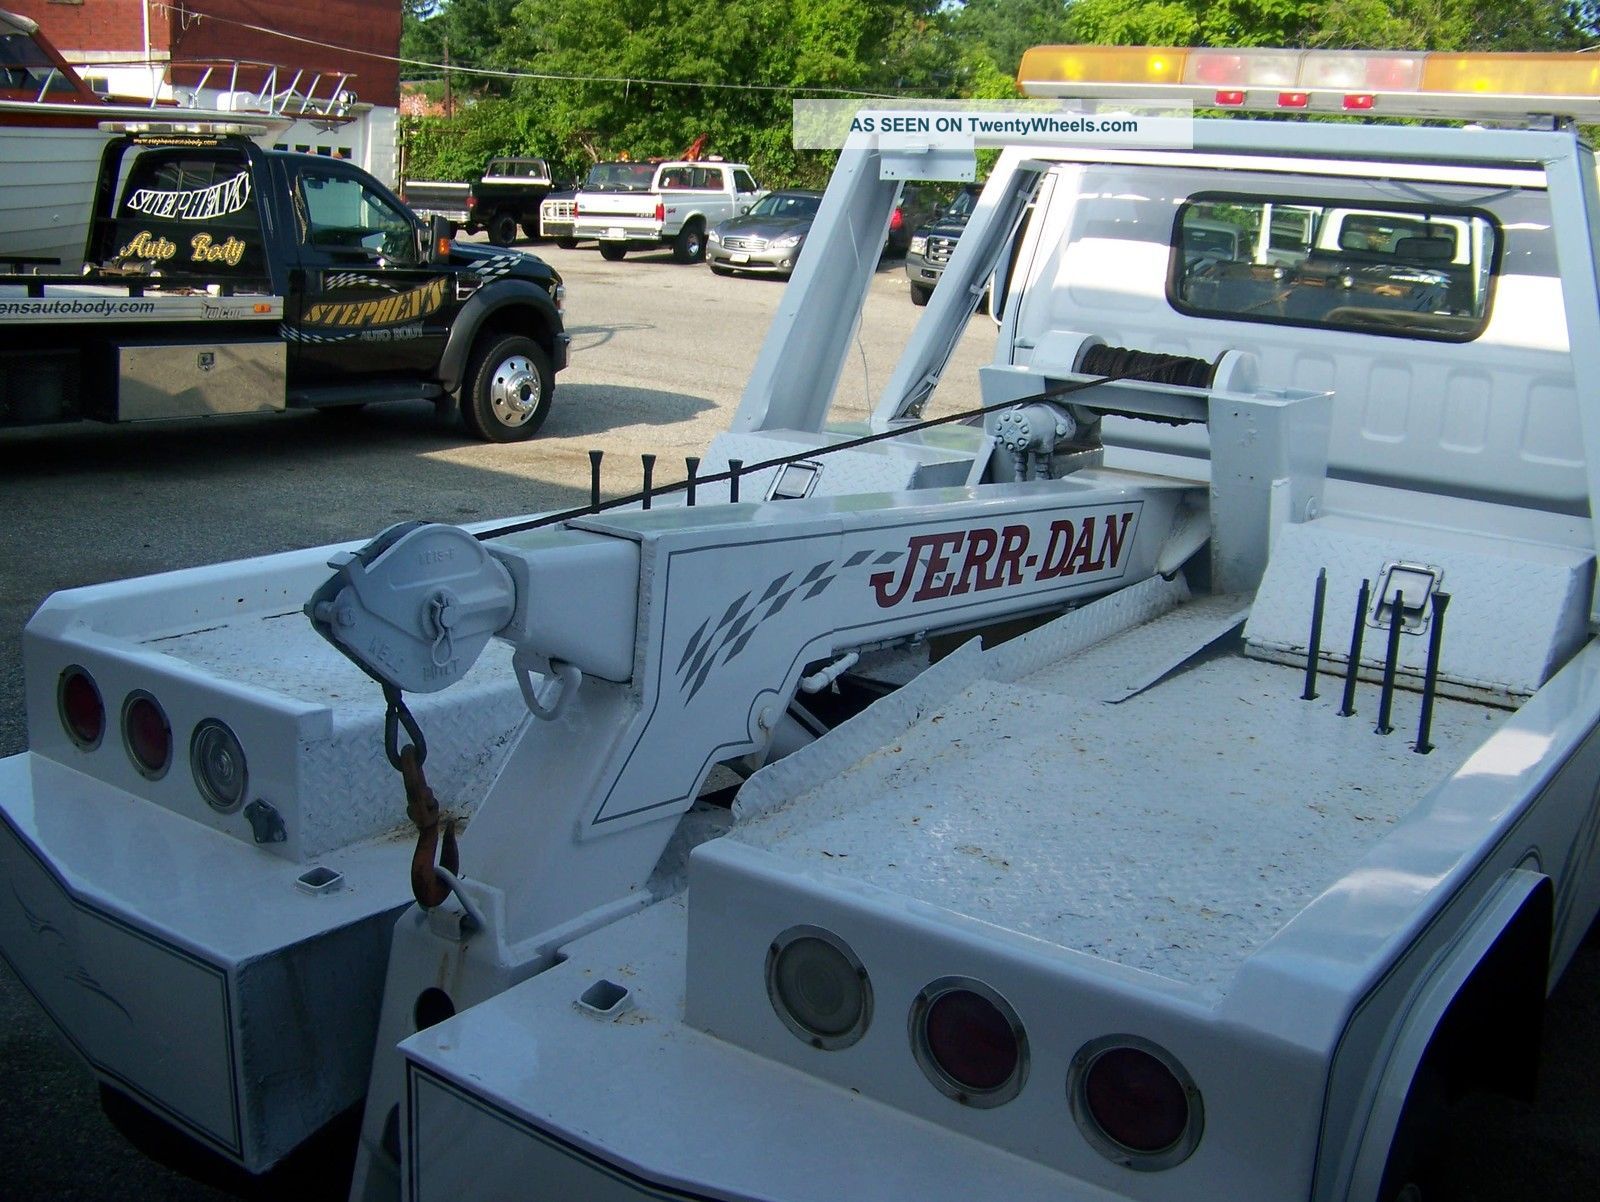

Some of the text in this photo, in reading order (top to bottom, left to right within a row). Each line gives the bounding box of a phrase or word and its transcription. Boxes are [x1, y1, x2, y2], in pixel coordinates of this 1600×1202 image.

[120, 231, 246, 266] Auto Body
[0, 300, 155, 316] ensautobody.com
[869, 512, 1133, 608] JERR-DAN
